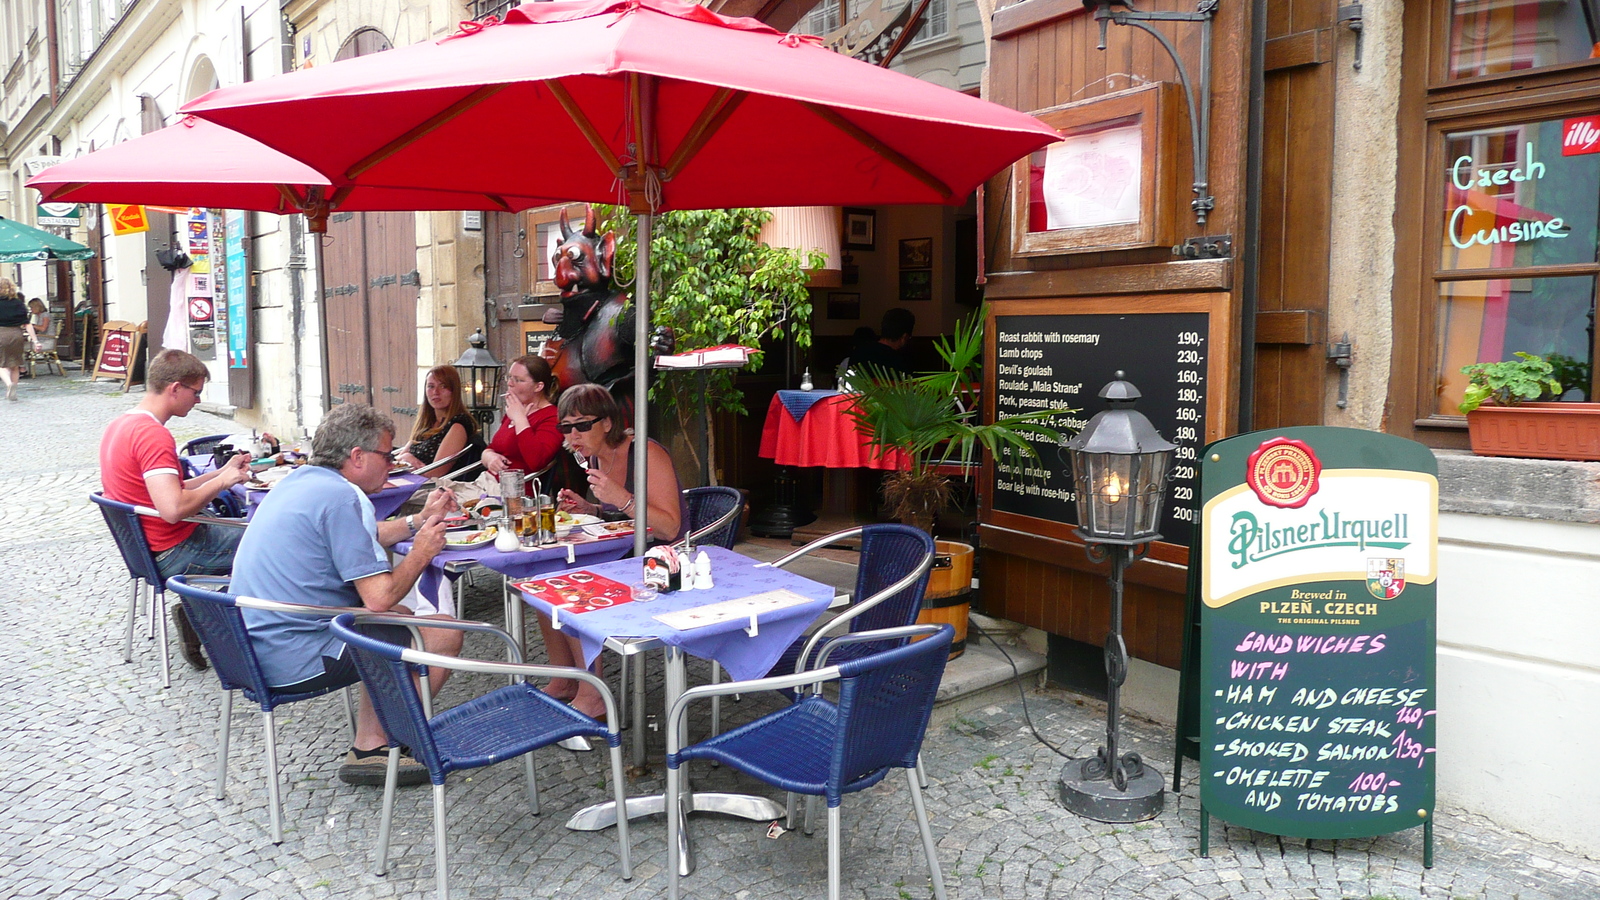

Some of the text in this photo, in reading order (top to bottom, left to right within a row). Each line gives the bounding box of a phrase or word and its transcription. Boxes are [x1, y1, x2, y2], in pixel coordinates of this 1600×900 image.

[1564, 121, 1600, 150] illy
[1453, 141, 1546, 190] Czech
[39, 217, 79, 225] RESTAURANT
[121, 213, 140, 221] Kodak
[1449, 205, 1569, 249] Cuisine
[999, 331, 1204, 347] Roast rabbit with rosemary 190,-
[999, 347, 1204, 366] Lamb chops 230,-
[1023, 365, 1053, 378] goulash
[1177, 369, 1204, 386] 160,-
[999, 379, 1029, 391] Roulade
[1177, 388, 1203, 405] 180,-
[999, 394, 1018, 407] Pork,
[1018, 397, 1049, 409] peasant
[1176, 407, 1202, 424] 160,-
[997, 479, 1014, 491] Boar
[1014, 481, 1025, 496] leg
[1025, 484, 1040, 496] with
[1041, 487, 1070, 503] rose-hip
[1173, 506, 1192, 522] 200
[1174, 486, 1193, 501] 220
[1228, 508, 1408, 570] Pilsner Urquell
[1291, 589, 1347, 601] Brewed in
[1260, 598, 1313, 614] PLZEŇ
[1325, 602, 1378, 615] CZECH
[1293, 617, 1329, 625] ORIGINAL
[1235, 631, 1387, 655] SANDWICHES
[1231, 659, 1289, 681] WITH
[1291, 687, 1337, 710] AND
[1340, 687, 1428, 707] CHEESE
[1327, 716, 1392, 739] STEAK
[1316, 742, 1397, 762] SALMON
[1245, 789, 1399, 814] AND TOMATOES
